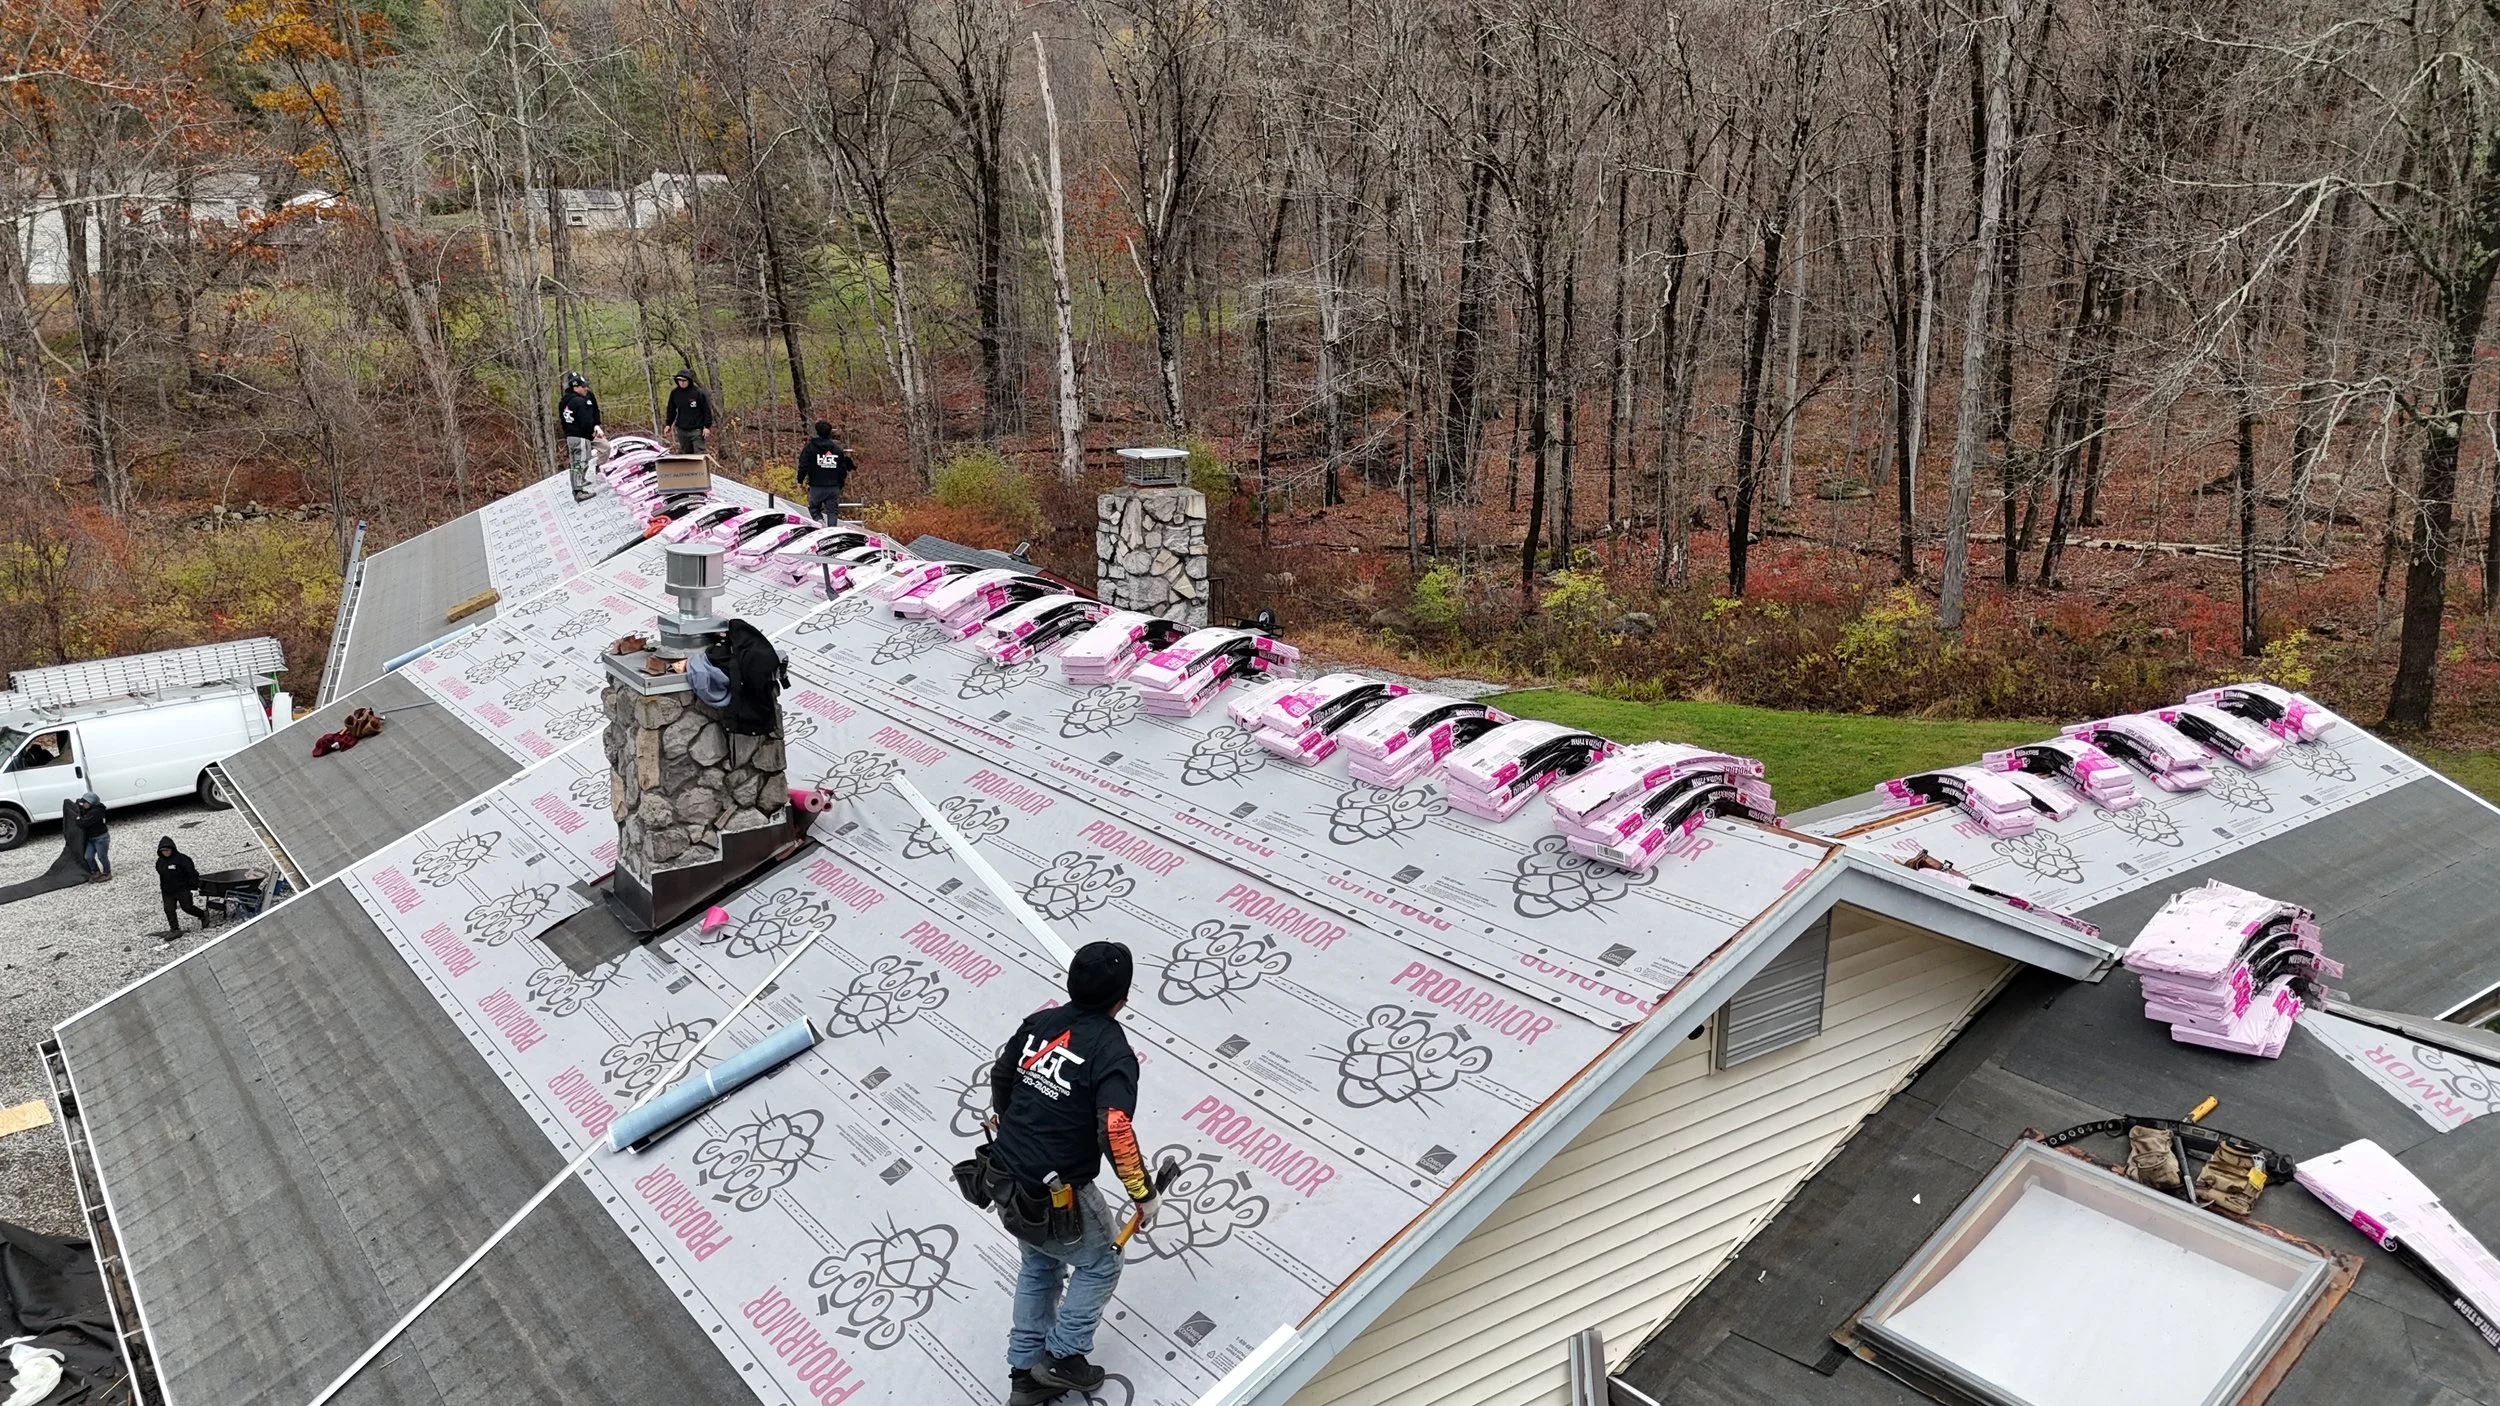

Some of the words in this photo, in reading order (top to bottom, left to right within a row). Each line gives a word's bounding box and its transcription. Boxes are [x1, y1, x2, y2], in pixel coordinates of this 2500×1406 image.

[787, 688, 857, 724] PROARMOR
[867, 724, 947, 767] PROARMOR
[530, 790, 590, 836] PROARMOR
[962, 768, 1056, 816] PROARMOR
[1076, 819, 1186, 877] PROARMOR
[372, 865, 426, 914] PROARMOR
[800, 857, 885, 914] PROARMOR
[1215, 882, 1347, 952] PROARMOR
[419, 921, 482, 978] PROARMOR
[899, 919, 1003, 989] PROARMOR
[477, 986, 549, 1053] PROARMOR
[1390, 960, 1556, 1047] PROARMOR
[547, 1065, 620, 1139] ROARMOR
[1182, 1094, 1336, 1199] PROARMOR
[634, 1162, 734, 1263] PROARMOR
[743, 1284, 866, 1406] PROARMOR
